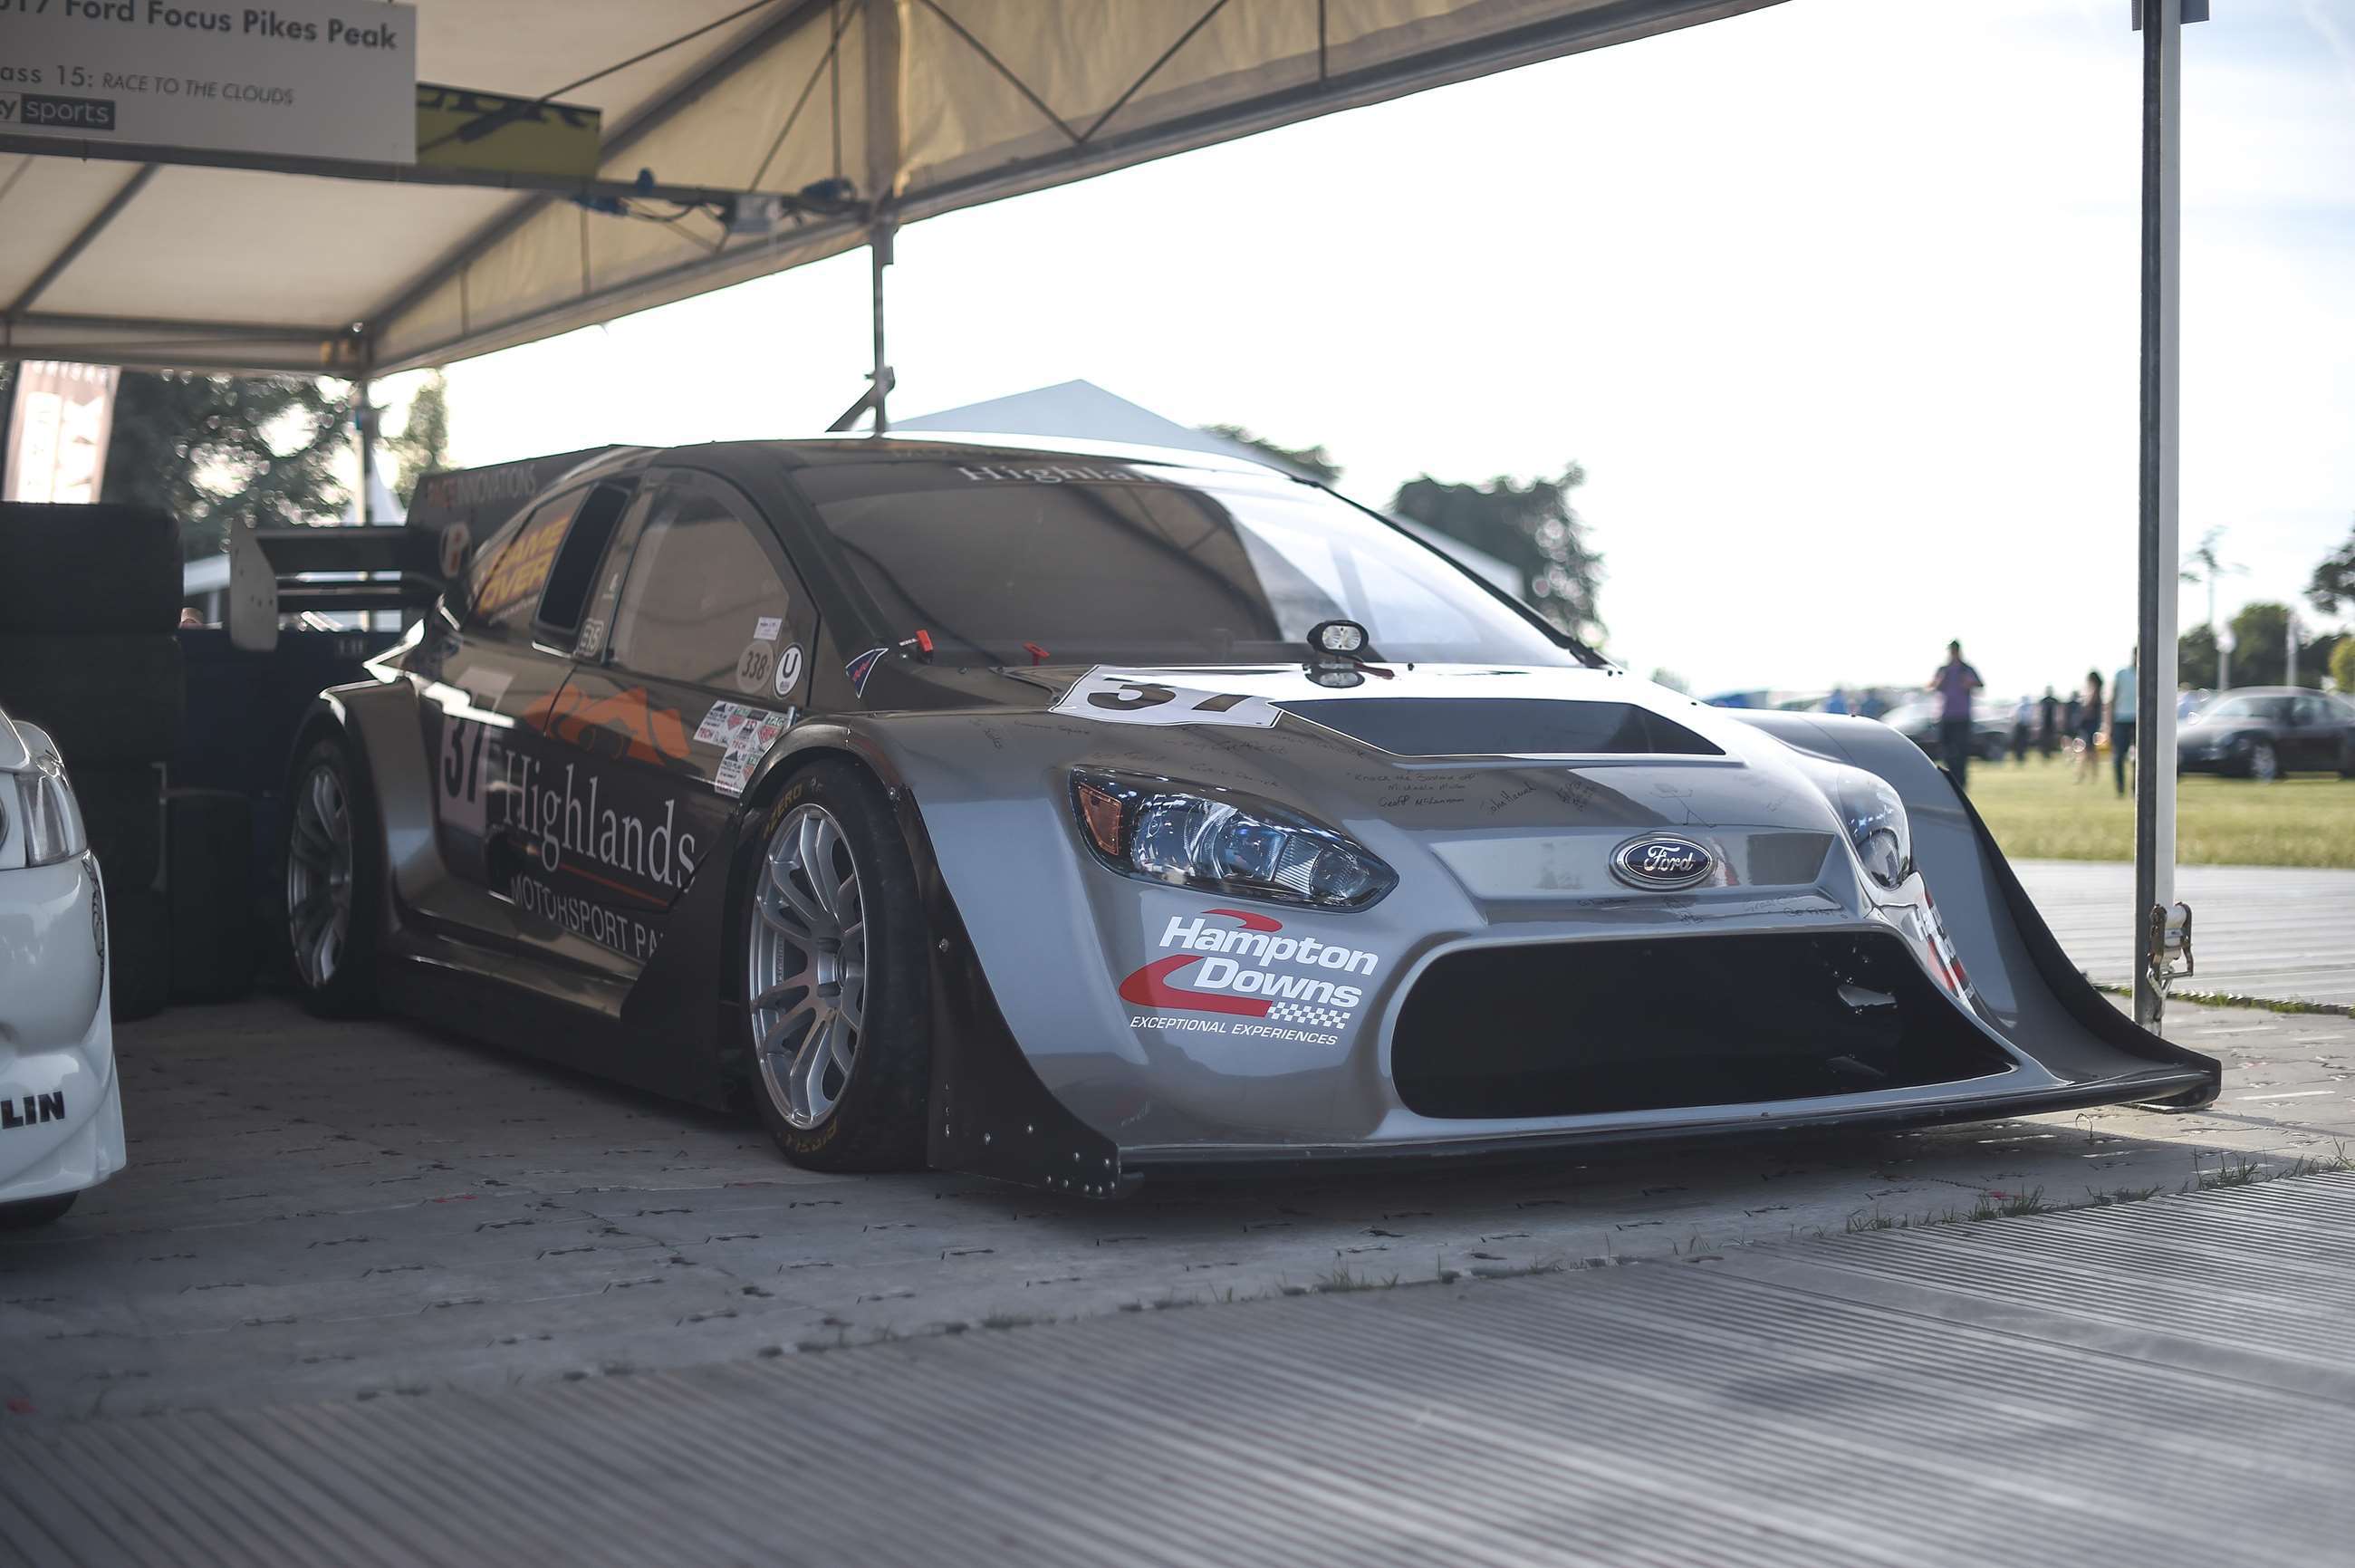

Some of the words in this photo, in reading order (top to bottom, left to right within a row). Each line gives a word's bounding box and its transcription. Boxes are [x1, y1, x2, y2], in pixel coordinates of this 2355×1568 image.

[64, 0, 135, 22] Ford
[147, 0, 232, 33] Focus
[243, 9, 318, 42] Pikes
[327, 18, 399, 50] Peak
[56, 64, 94, 88] 15:
[102, 72, 149, 91] RACE
[155, 76, 180, 95] TO
[186, 79, 218, 99] THE
[222, 82, 294, 106] CLOUDS
[25, 100, 110, 124] sports
[741, 651, 768, 681] 338
[782, 652, 799, 679] U
[504, 750, 696, 893] Highlands
[1644, 845, 1694, 871] Ford
[511, 871, 628, 951] MOTORSPORT
[634, 922, 664, 957] PA
[1158, 915, 1379, 976] Hampton
[1194, 957, 1363, 1008] Downs
[1129, 1015, 1226, 1034] EXCEPTIONAL
[1232, 1024, 1338, 1045] EXPERIENCES
[0, 1091, 65, 1130] LIN
